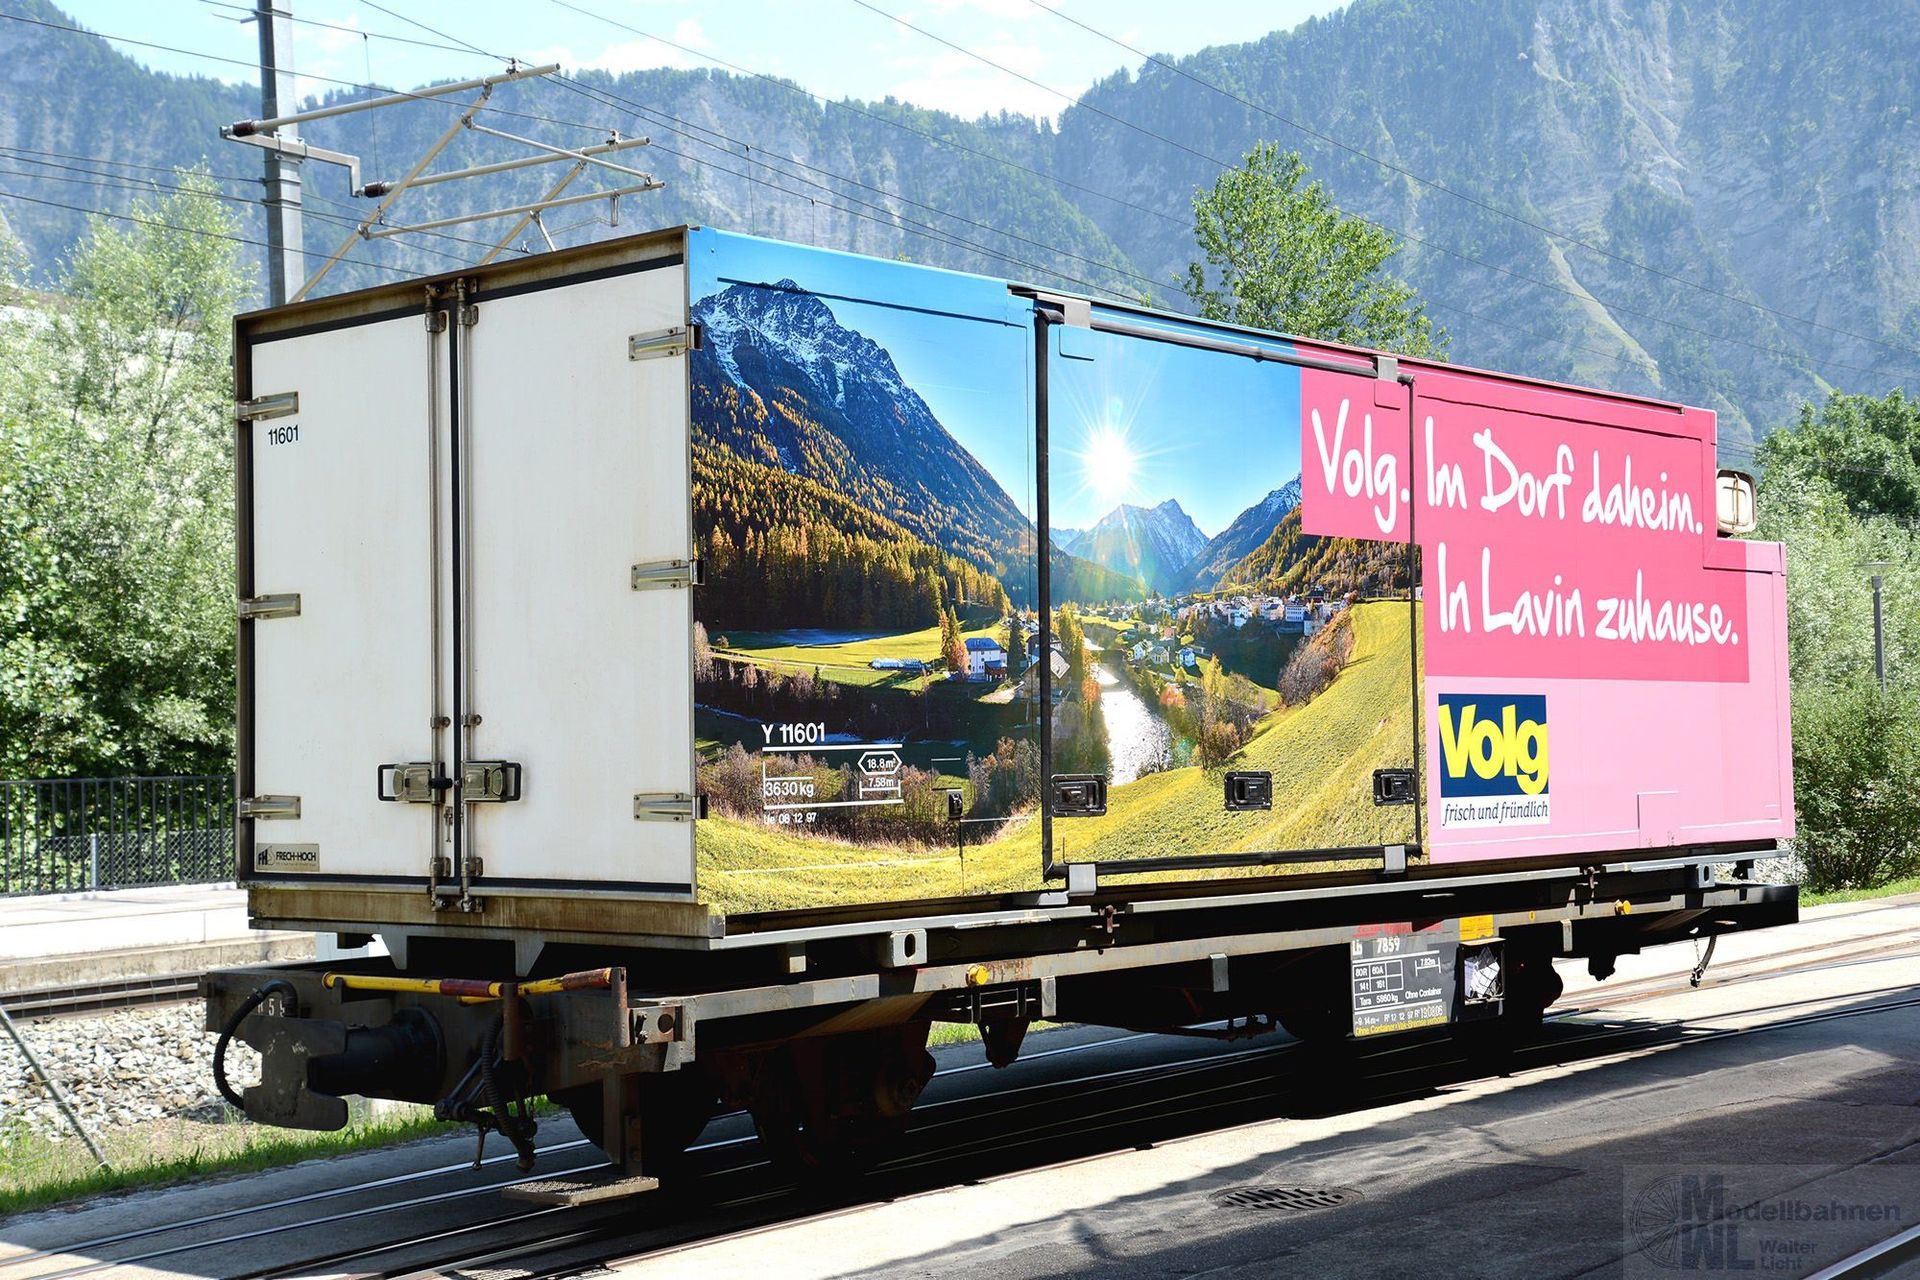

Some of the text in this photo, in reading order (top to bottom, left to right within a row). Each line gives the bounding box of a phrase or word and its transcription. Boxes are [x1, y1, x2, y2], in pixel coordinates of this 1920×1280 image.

[268, 424, 299, 445] 11601
[1312, 398, 1703, 535] Volg. Im Dorf daheim.
[1438, 542, 1739, 645] In Lavin zuhause.
[761, 722, 825, 744] Y 11601
[1438, 703, 1549, 795] Volg
[800, 781, 814, 798] kg
[779, 813, 790, 824] 08
[793, 812, 803, 823] 12
[806, 811, 817, 823] 97
[1442, 800, 1549, 827] frisch und fründlich
[276, 851, 317, 862] FRECH-HOCH
[1377, 935, 1400, 954] 7859
[1405, 987, 1442, 999] Ohne Container
